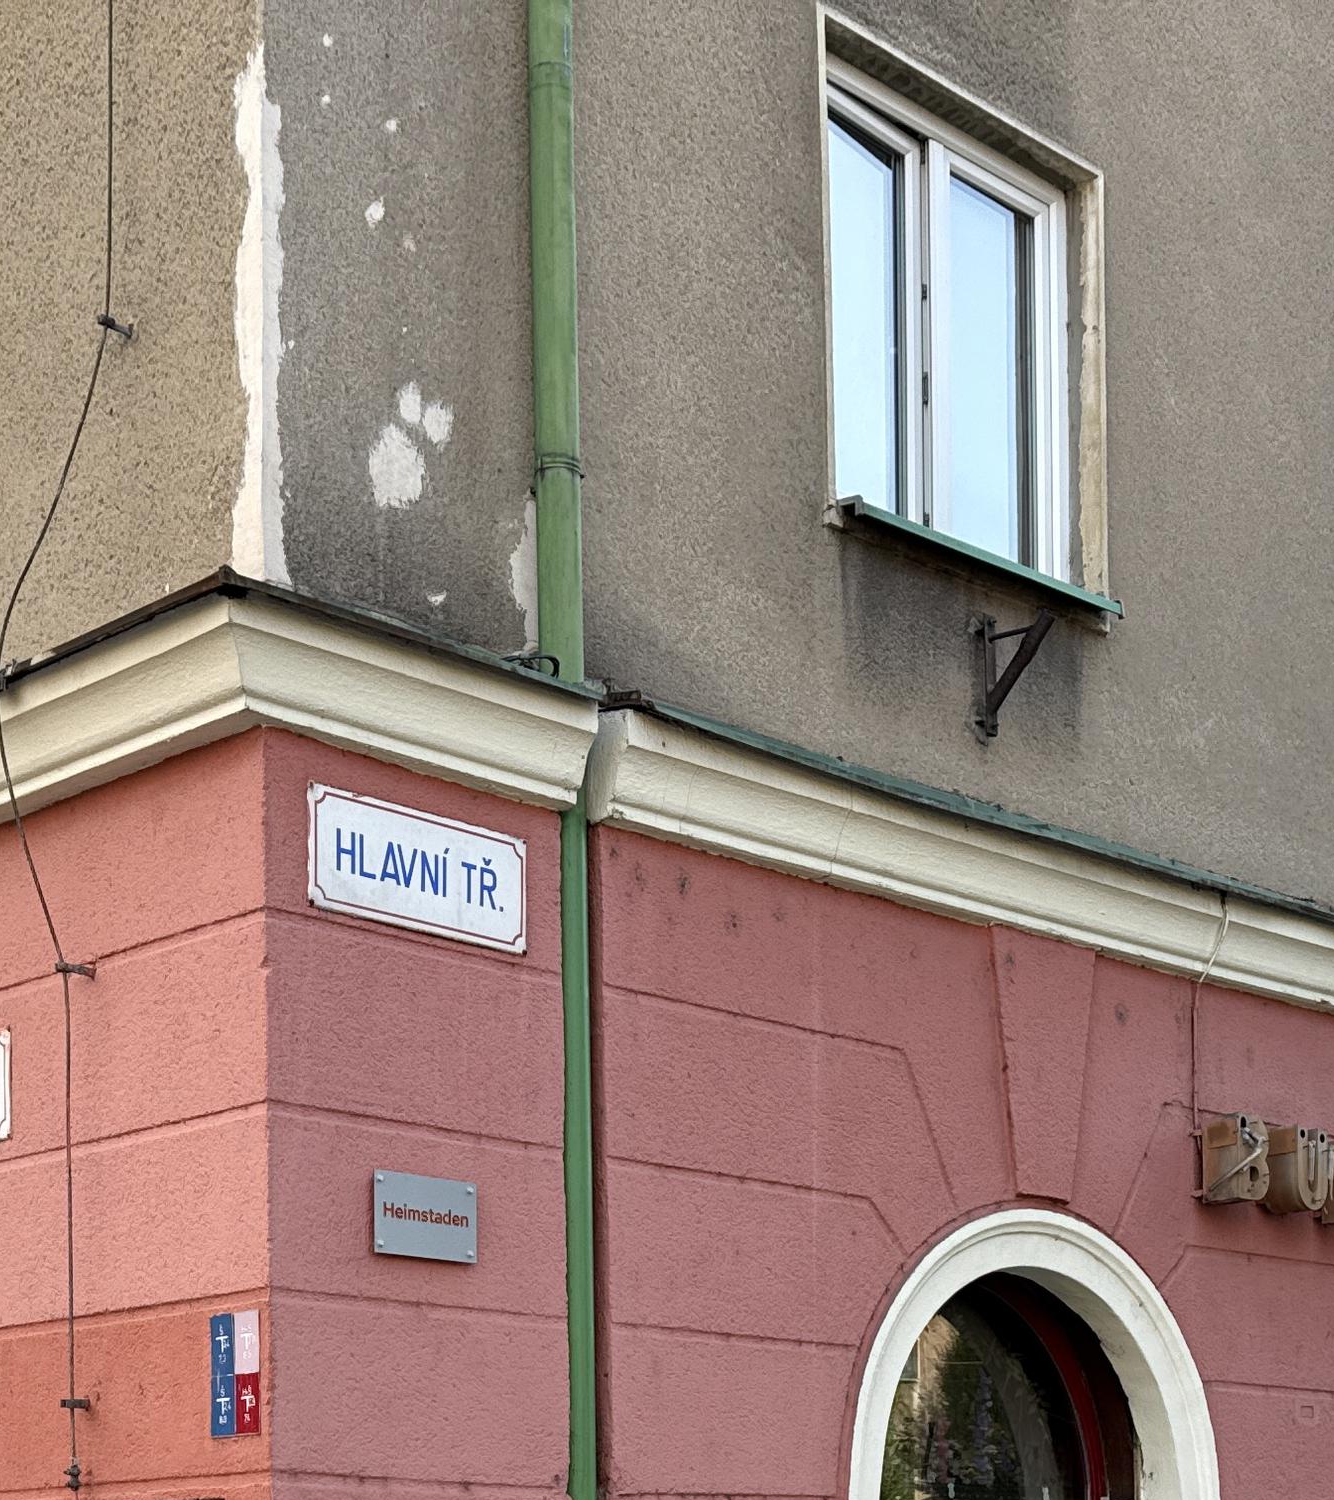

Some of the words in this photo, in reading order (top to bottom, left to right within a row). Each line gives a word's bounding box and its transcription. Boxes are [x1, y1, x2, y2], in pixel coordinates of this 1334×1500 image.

[336, 827, 450, 898] HLAVNÍ
[461, 856, 504, 913] TŘ.
[382, 1200, 470, 1229] Heimstaden
